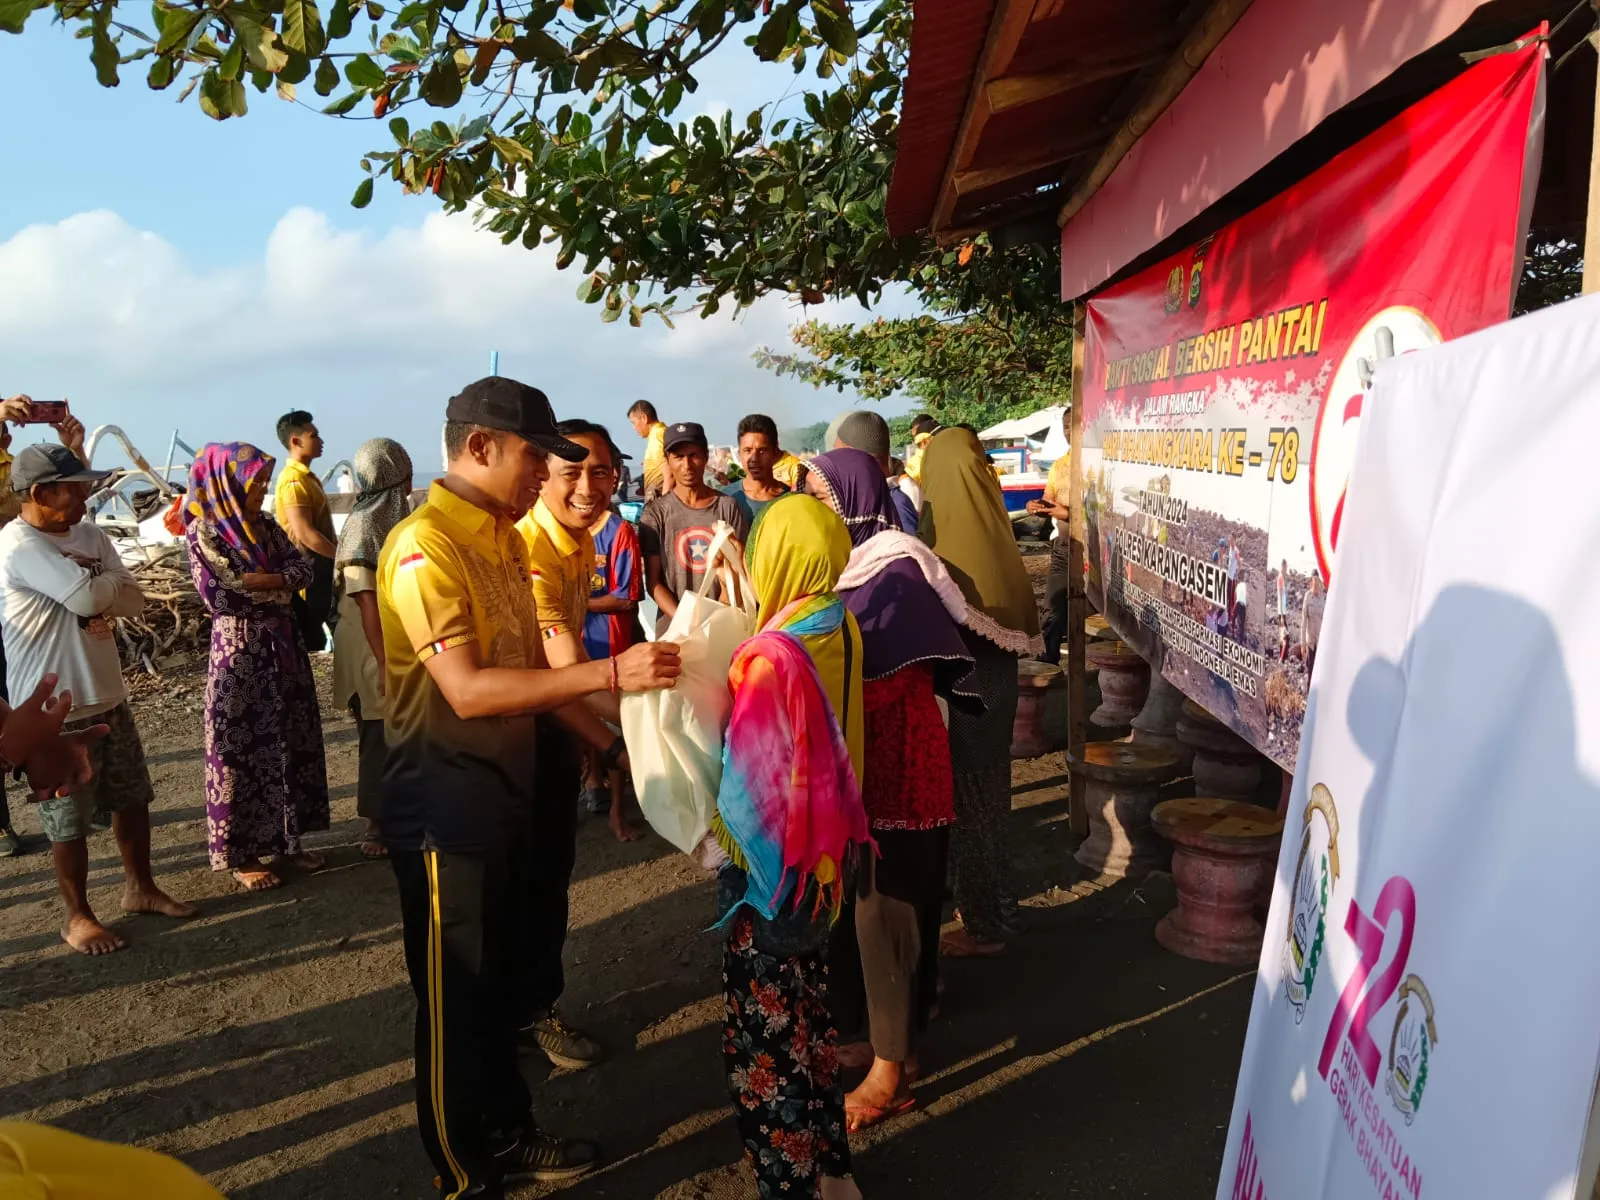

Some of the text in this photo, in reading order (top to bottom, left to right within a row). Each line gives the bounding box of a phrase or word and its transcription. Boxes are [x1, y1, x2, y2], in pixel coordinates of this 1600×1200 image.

[1131, 344, 1170, 385] SOSIAL
[1174, 325, 1236, 380] BERSIH
[1236, 297, 1328, 369] PANTAI
[1144, 390, 1205, 416] DALAM RANGKA
[1121, 428, 1212, 473] BHAYANGKARA
[1217, 428, 1247, 476] KE
[1139, 489, 1188, 527] TAHUN 2024
[1115, 526, 1228, 609] POLRES KARANGASEM
[1172, 608, 1222, 654] TRANSFORMASI
[1222, 636, 1265, 677] EKONOMI
[1191, 642, 1232, 682] INDONESIA
[1231, 665, 1257, 698] EMAS
[1330, 1068, 1404, 1200] GERAK BHAYA
[1341, 1040, 1423, 1200] HARI KESATUAN
